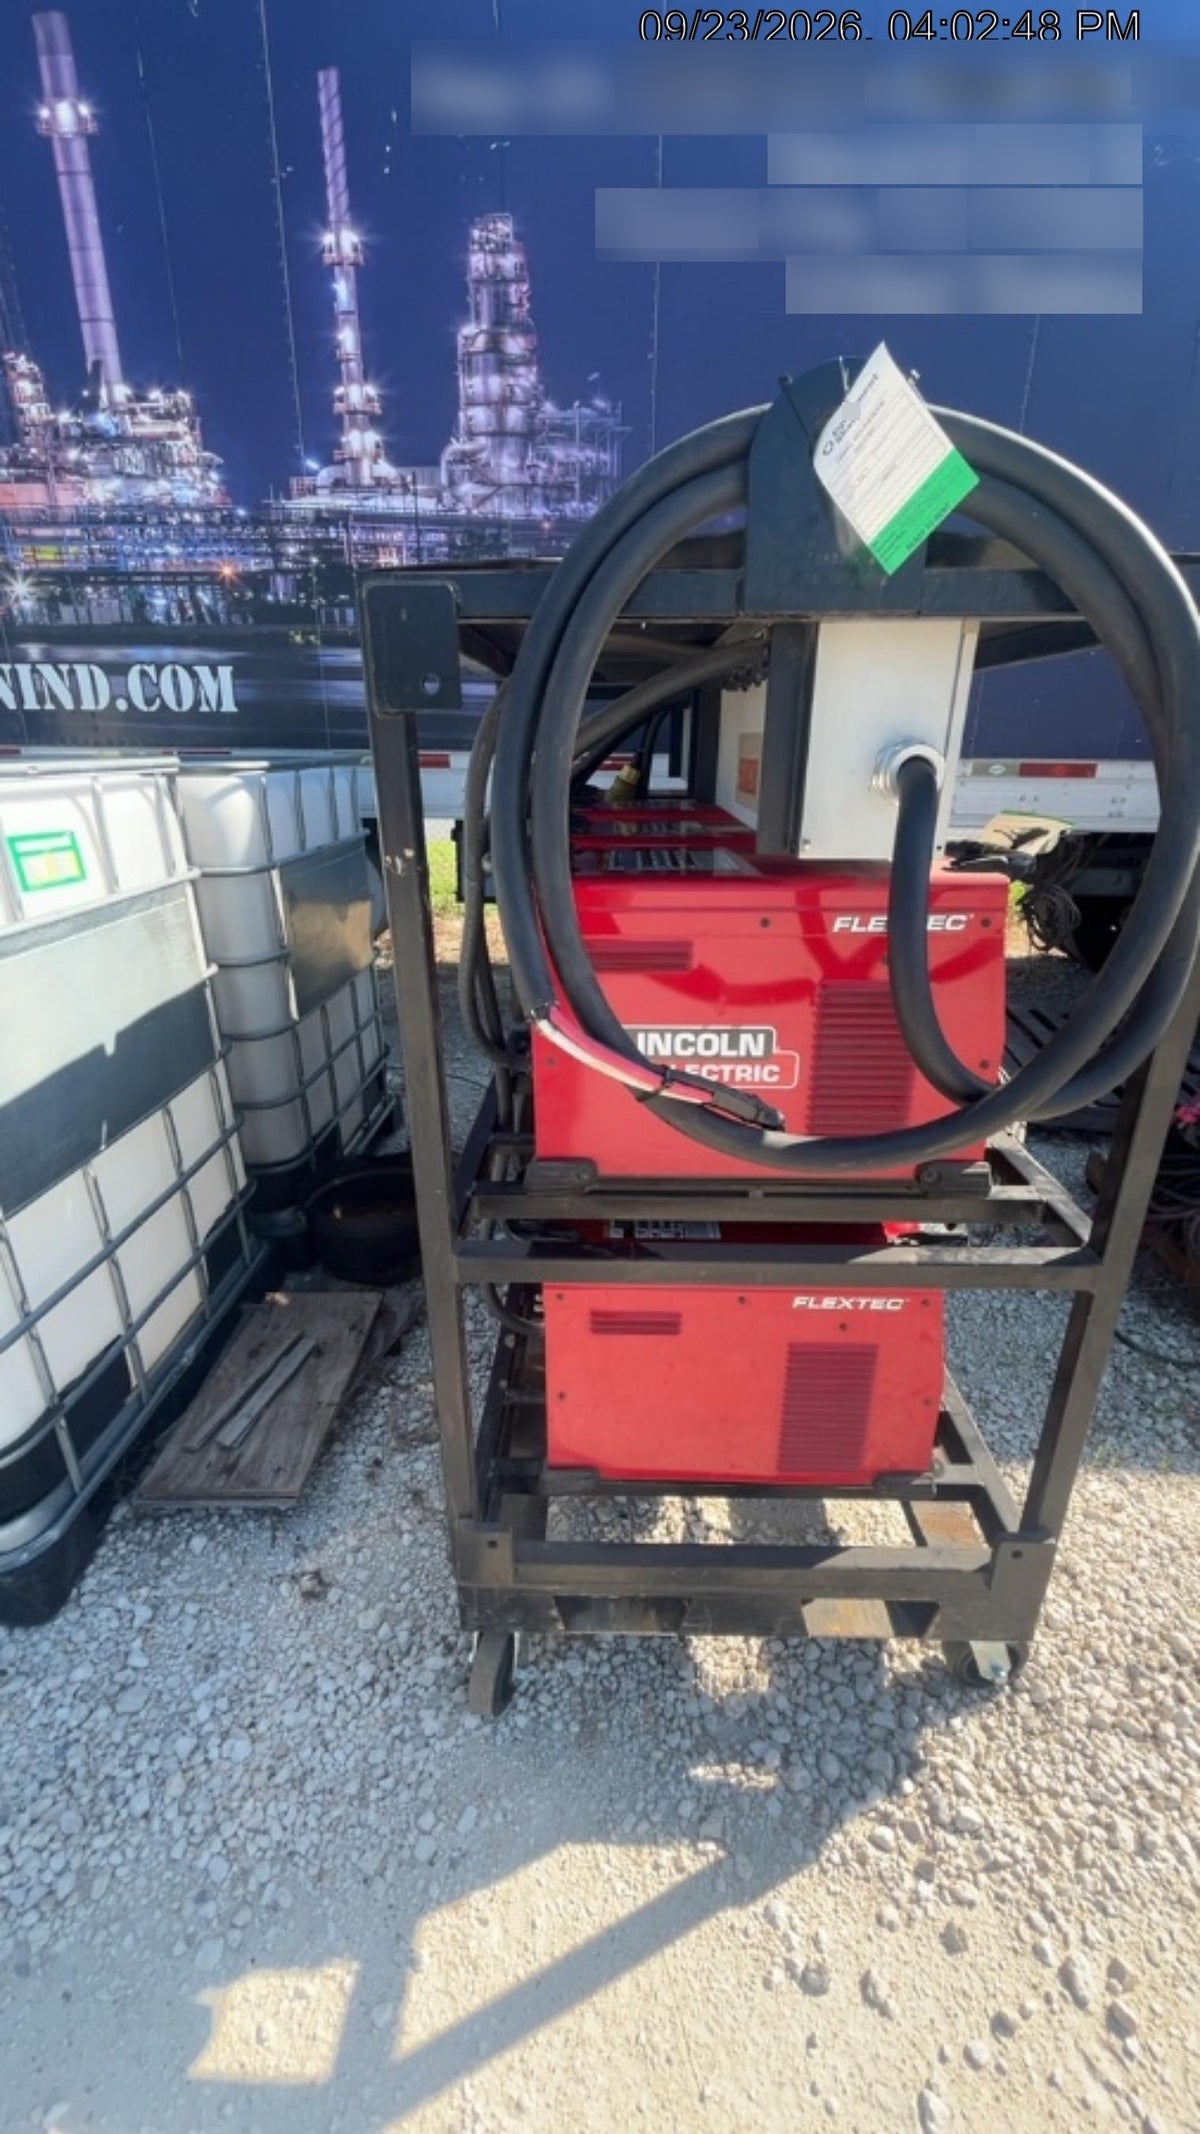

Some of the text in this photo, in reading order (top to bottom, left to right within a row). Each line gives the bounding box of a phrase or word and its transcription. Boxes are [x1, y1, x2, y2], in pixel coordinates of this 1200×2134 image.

[832, 914, 967, 933] FLEEC
[636, 1032, 766, 1057] INCOLN
[671, 1063, 781, 1083] ECTRIC
[791, 1296, 905, 1310] FLEXTEC
